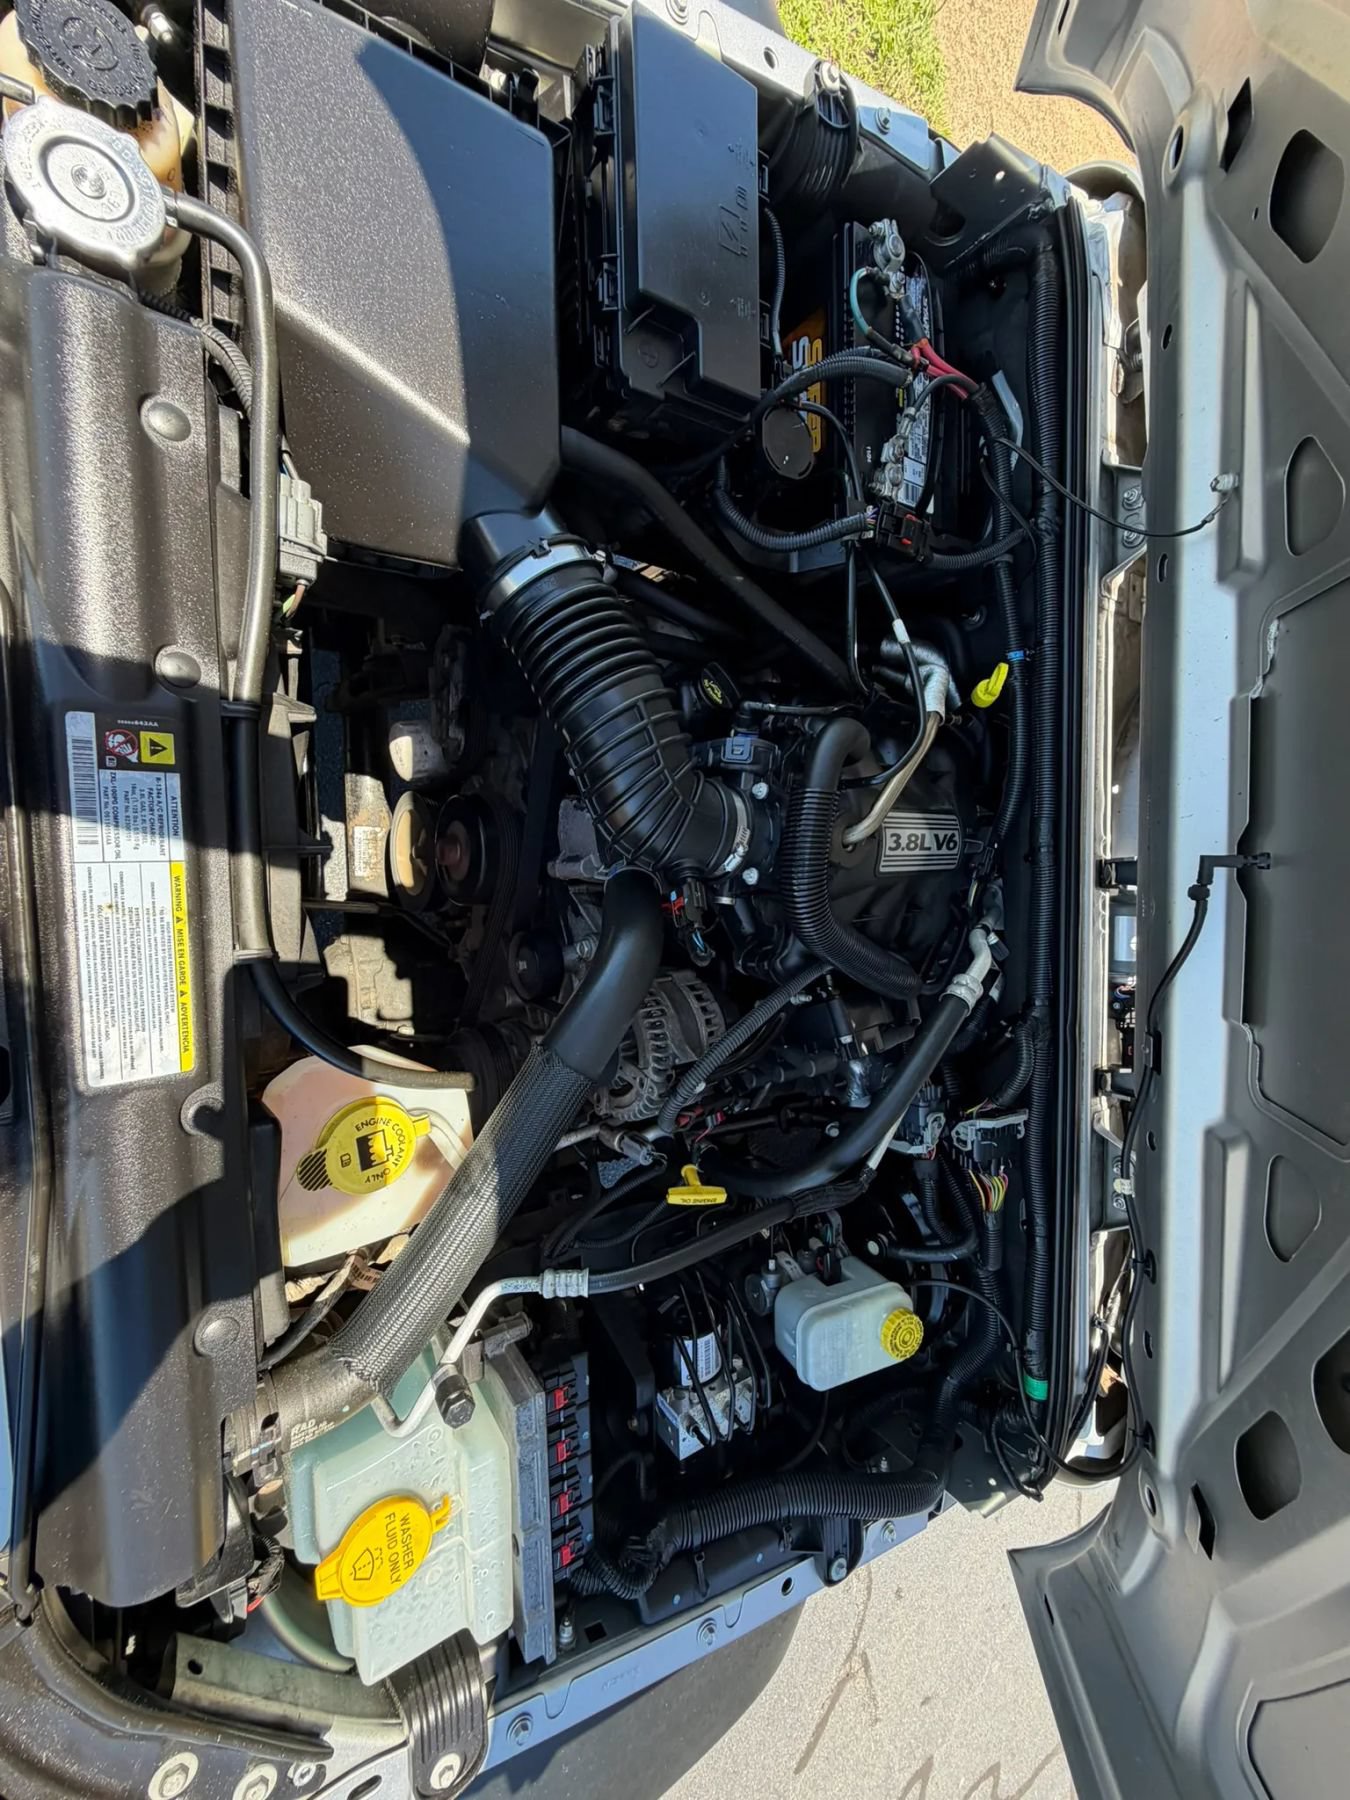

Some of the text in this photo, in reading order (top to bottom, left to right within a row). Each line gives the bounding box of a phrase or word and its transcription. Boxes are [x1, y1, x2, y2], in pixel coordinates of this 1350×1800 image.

[806, 338, 822, 453] SPER
[146, 787, 154, 815] FACTORY
[170, 795, 178, 836] ATTENTION
[112, 805, 120, 848] COMPRESSOR
[157, 814, 165, 856] REFRIGERANT
[888, 832, 958, 851] 3.8L V6
[173, 875, 190, 1053] WARNING MISE EN GARDE ADVERTENCIA
[355, 1117, 406, 1184] ENGINE COOLANT ONLY
[384, 1512, 402, 1585] FLUID ONLY
[400, 1513, 415, 1570] WASHER
